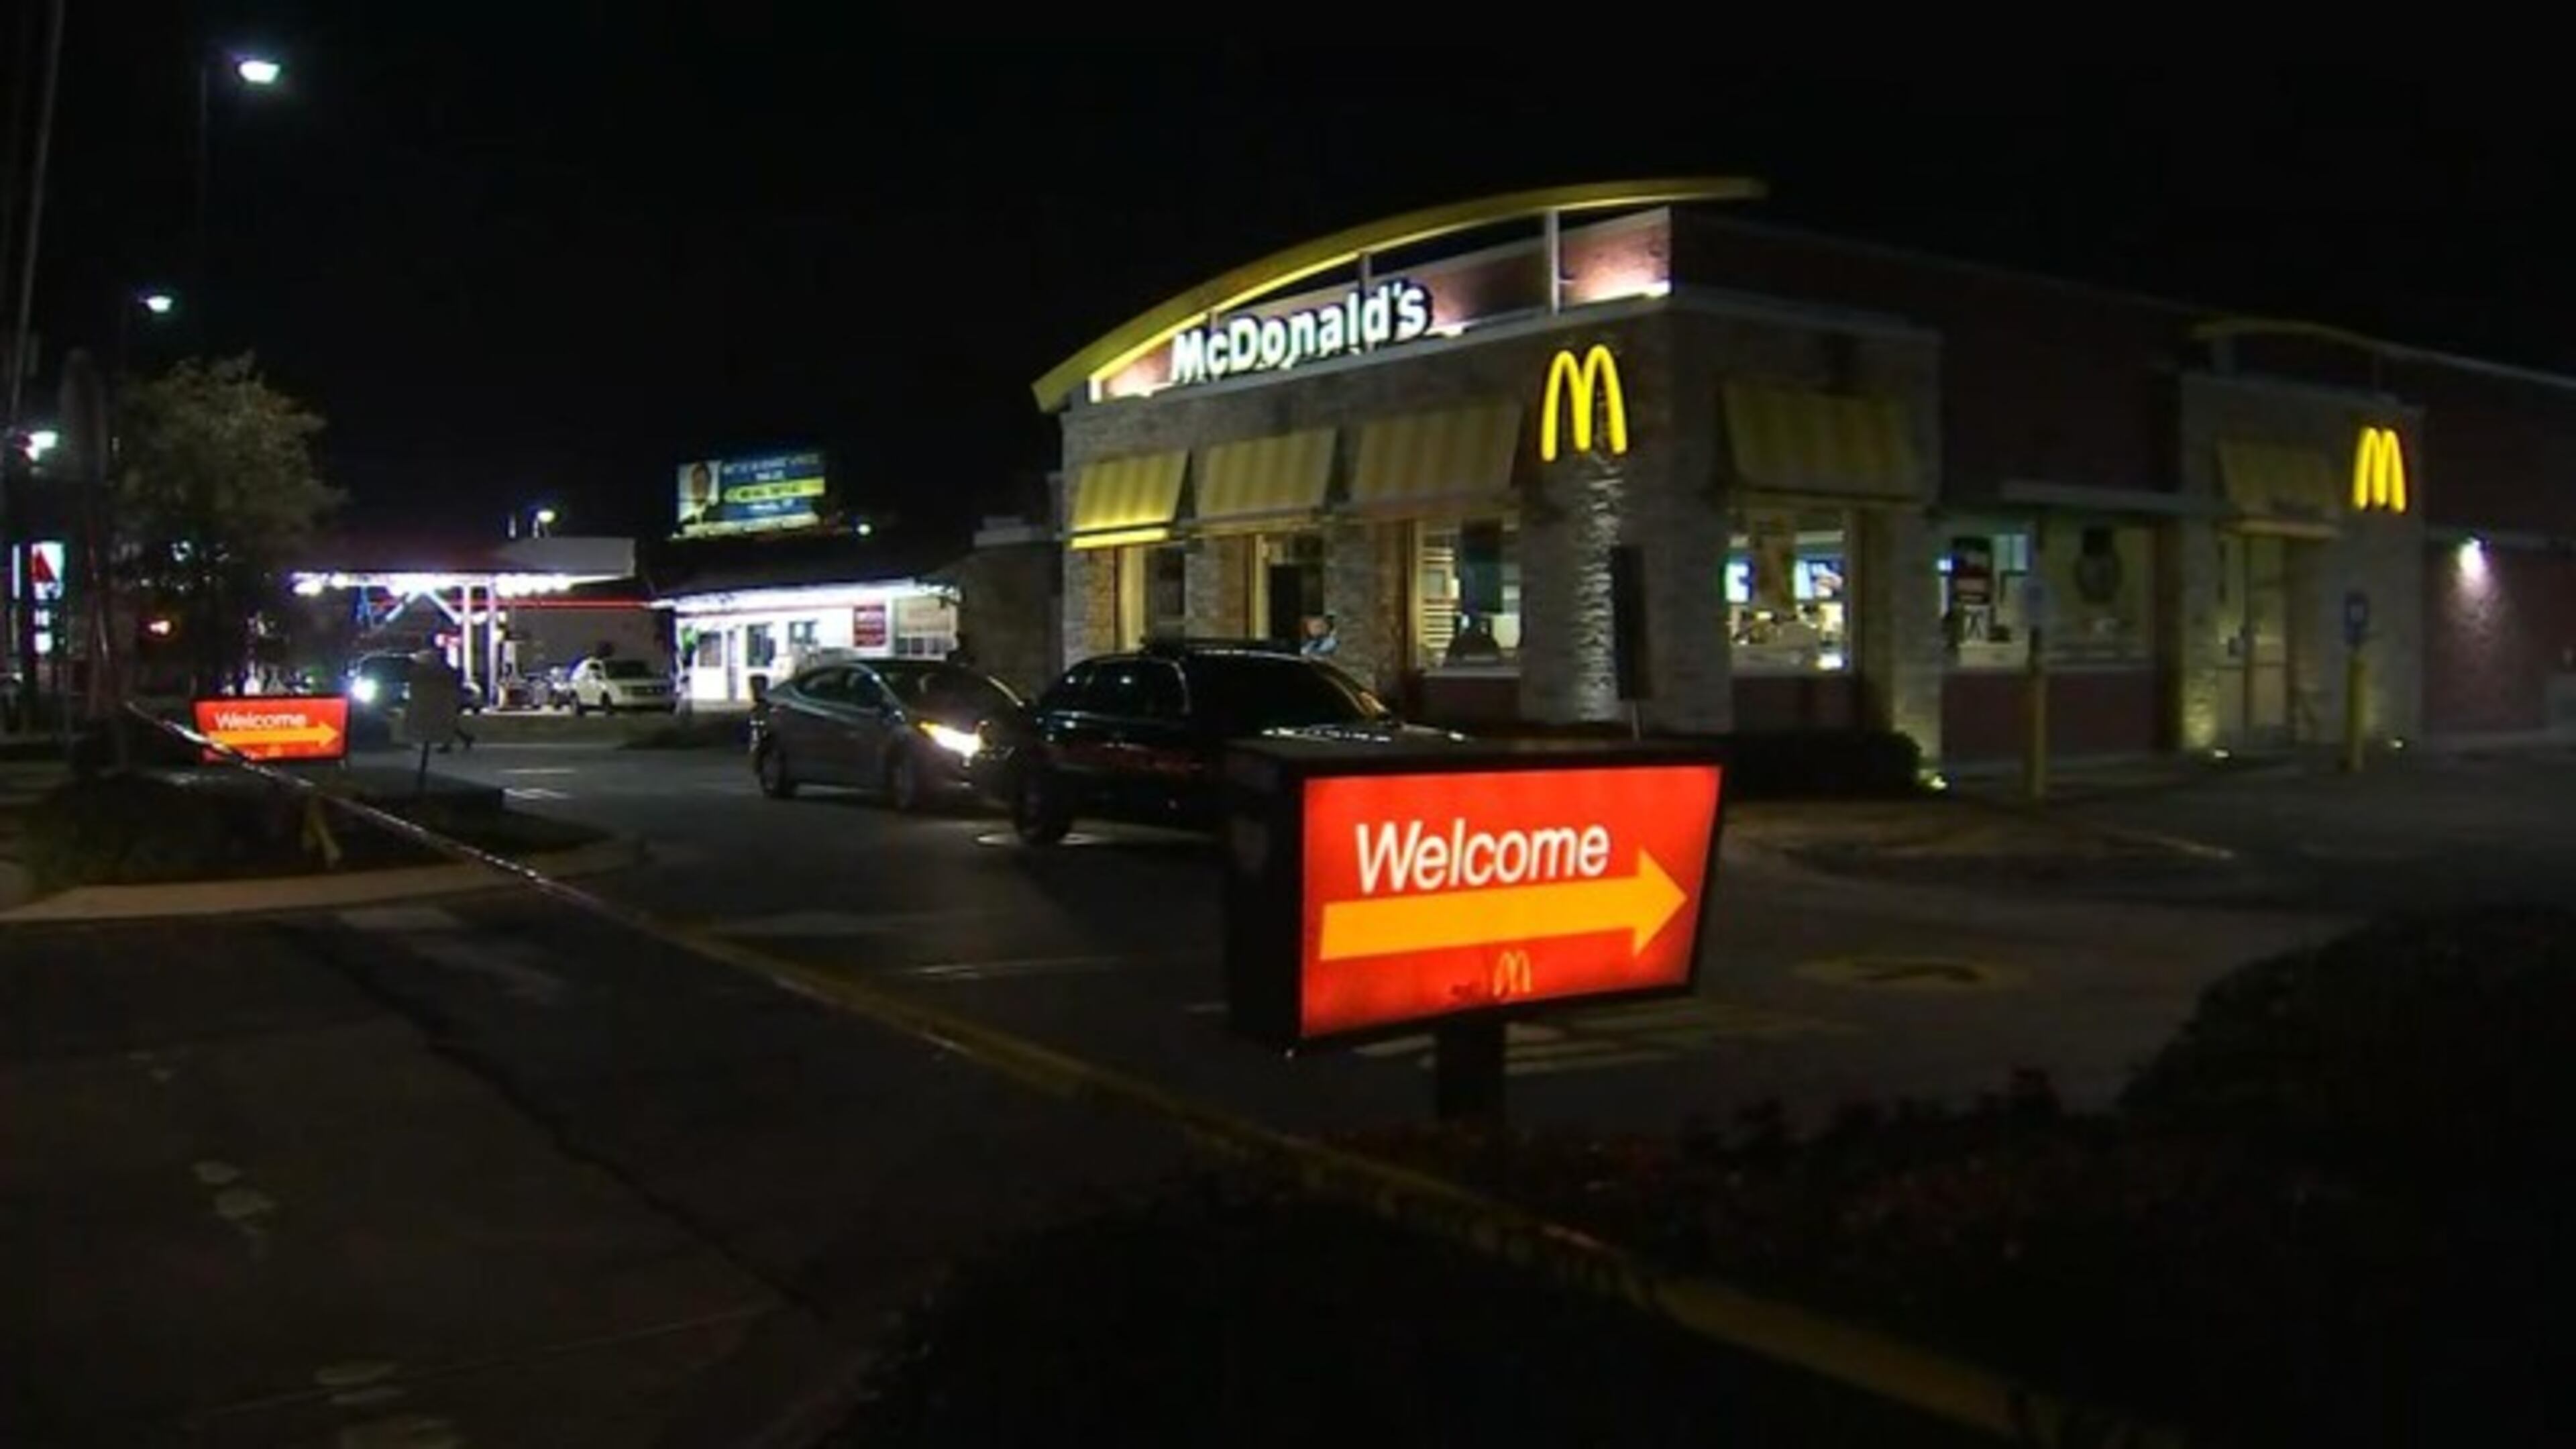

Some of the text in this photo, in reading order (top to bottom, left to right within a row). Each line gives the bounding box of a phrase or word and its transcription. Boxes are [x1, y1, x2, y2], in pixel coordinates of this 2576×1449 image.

[1171, 282, 1428, 383] McDonald's
[214, 712, 308, 731] Welcome
[1355, 817, 1609, 894] Welcome
